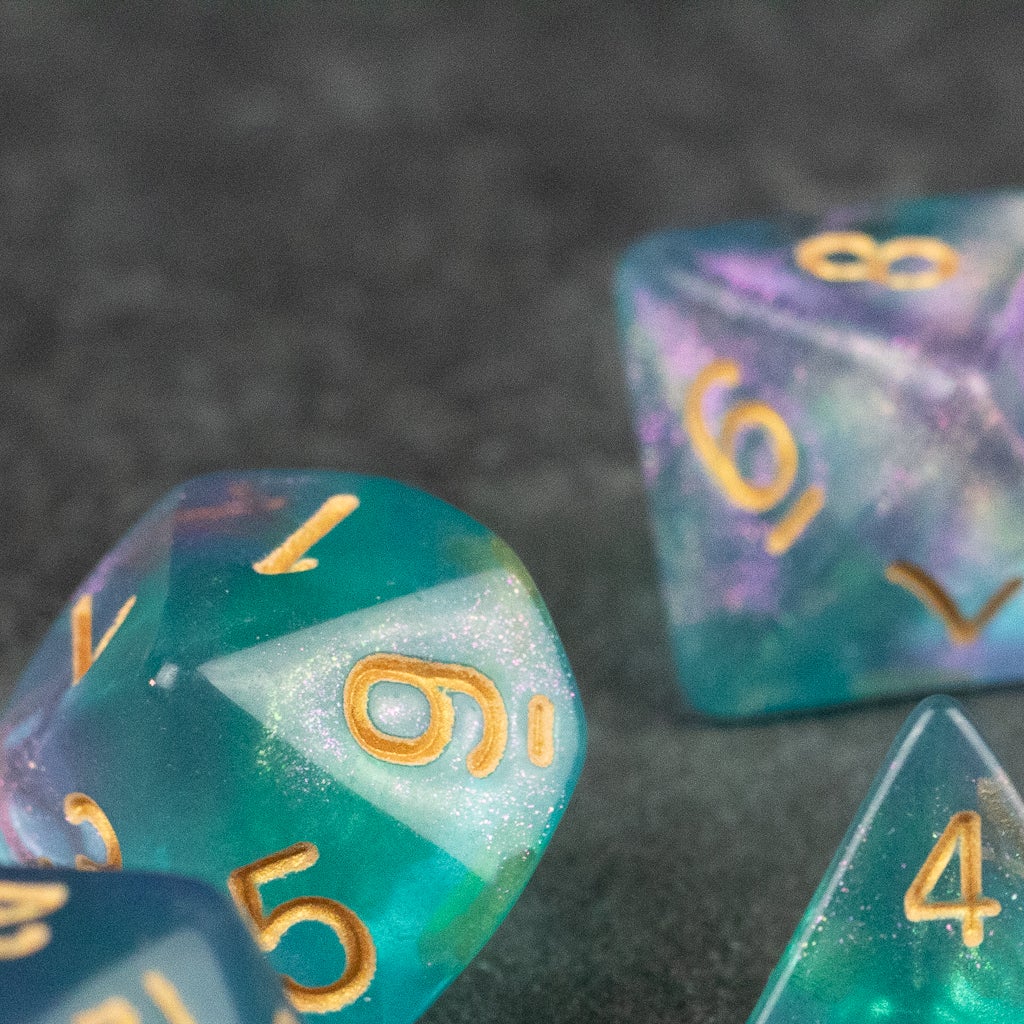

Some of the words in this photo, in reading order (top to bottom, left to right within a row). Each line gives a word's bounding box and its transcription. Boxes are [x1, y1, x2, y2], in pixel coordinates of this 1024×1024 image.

[795, 231, 961, 291] 8
[227, 841, 377, 1014] 5
[904, 811, 1002, 948] 4
